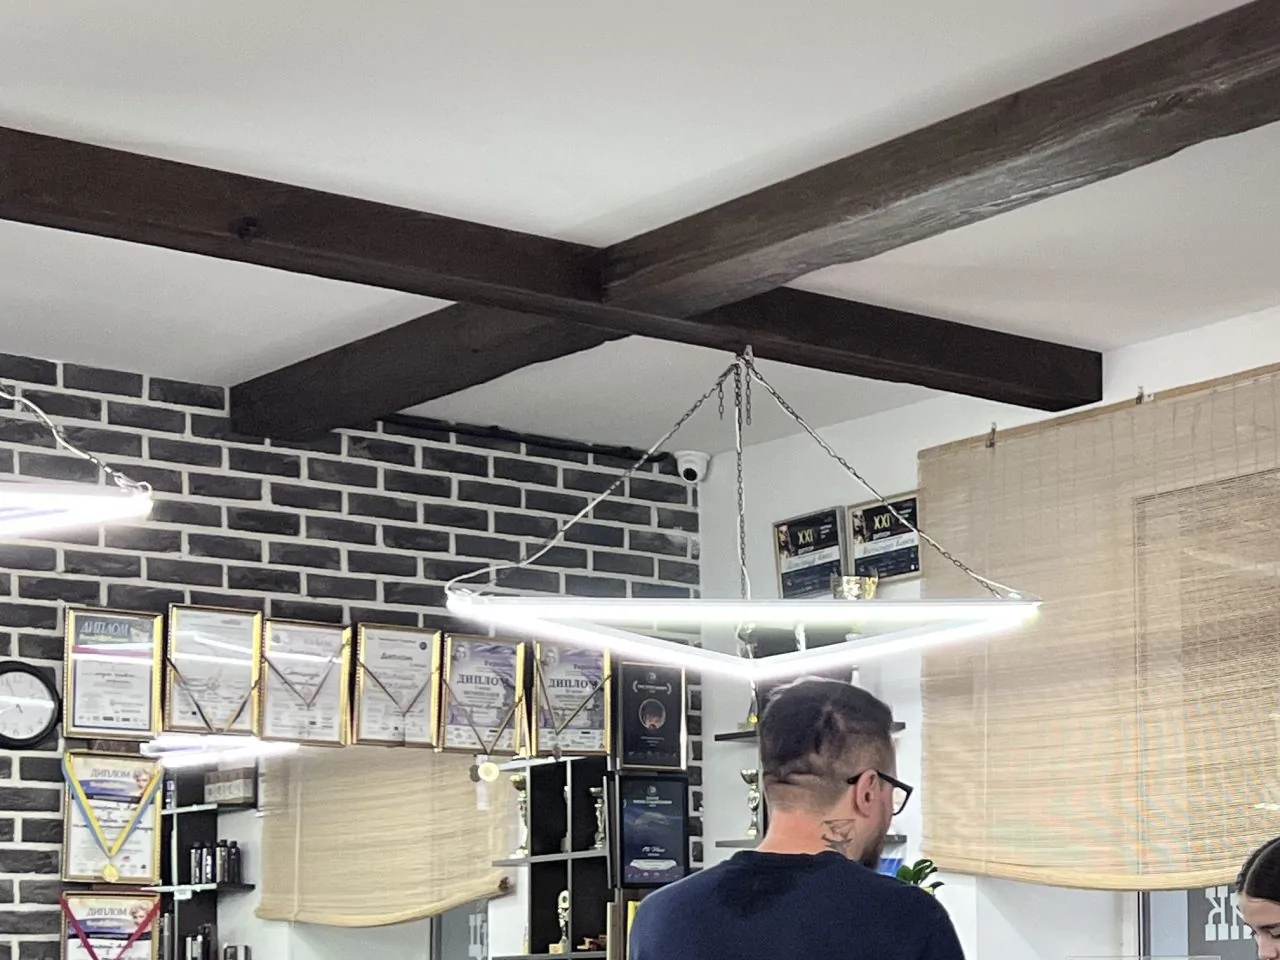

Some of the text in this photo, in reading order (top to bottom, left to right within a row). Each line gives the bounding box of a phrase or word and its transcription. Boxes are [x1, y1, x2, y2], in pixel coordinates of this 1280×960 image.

[80, 620, 129, 638] ДИПЛОМ
[90, 768, 131, 779] ДИПЛОМ
[86, 907, 127, 917] ДИПЛОМ
